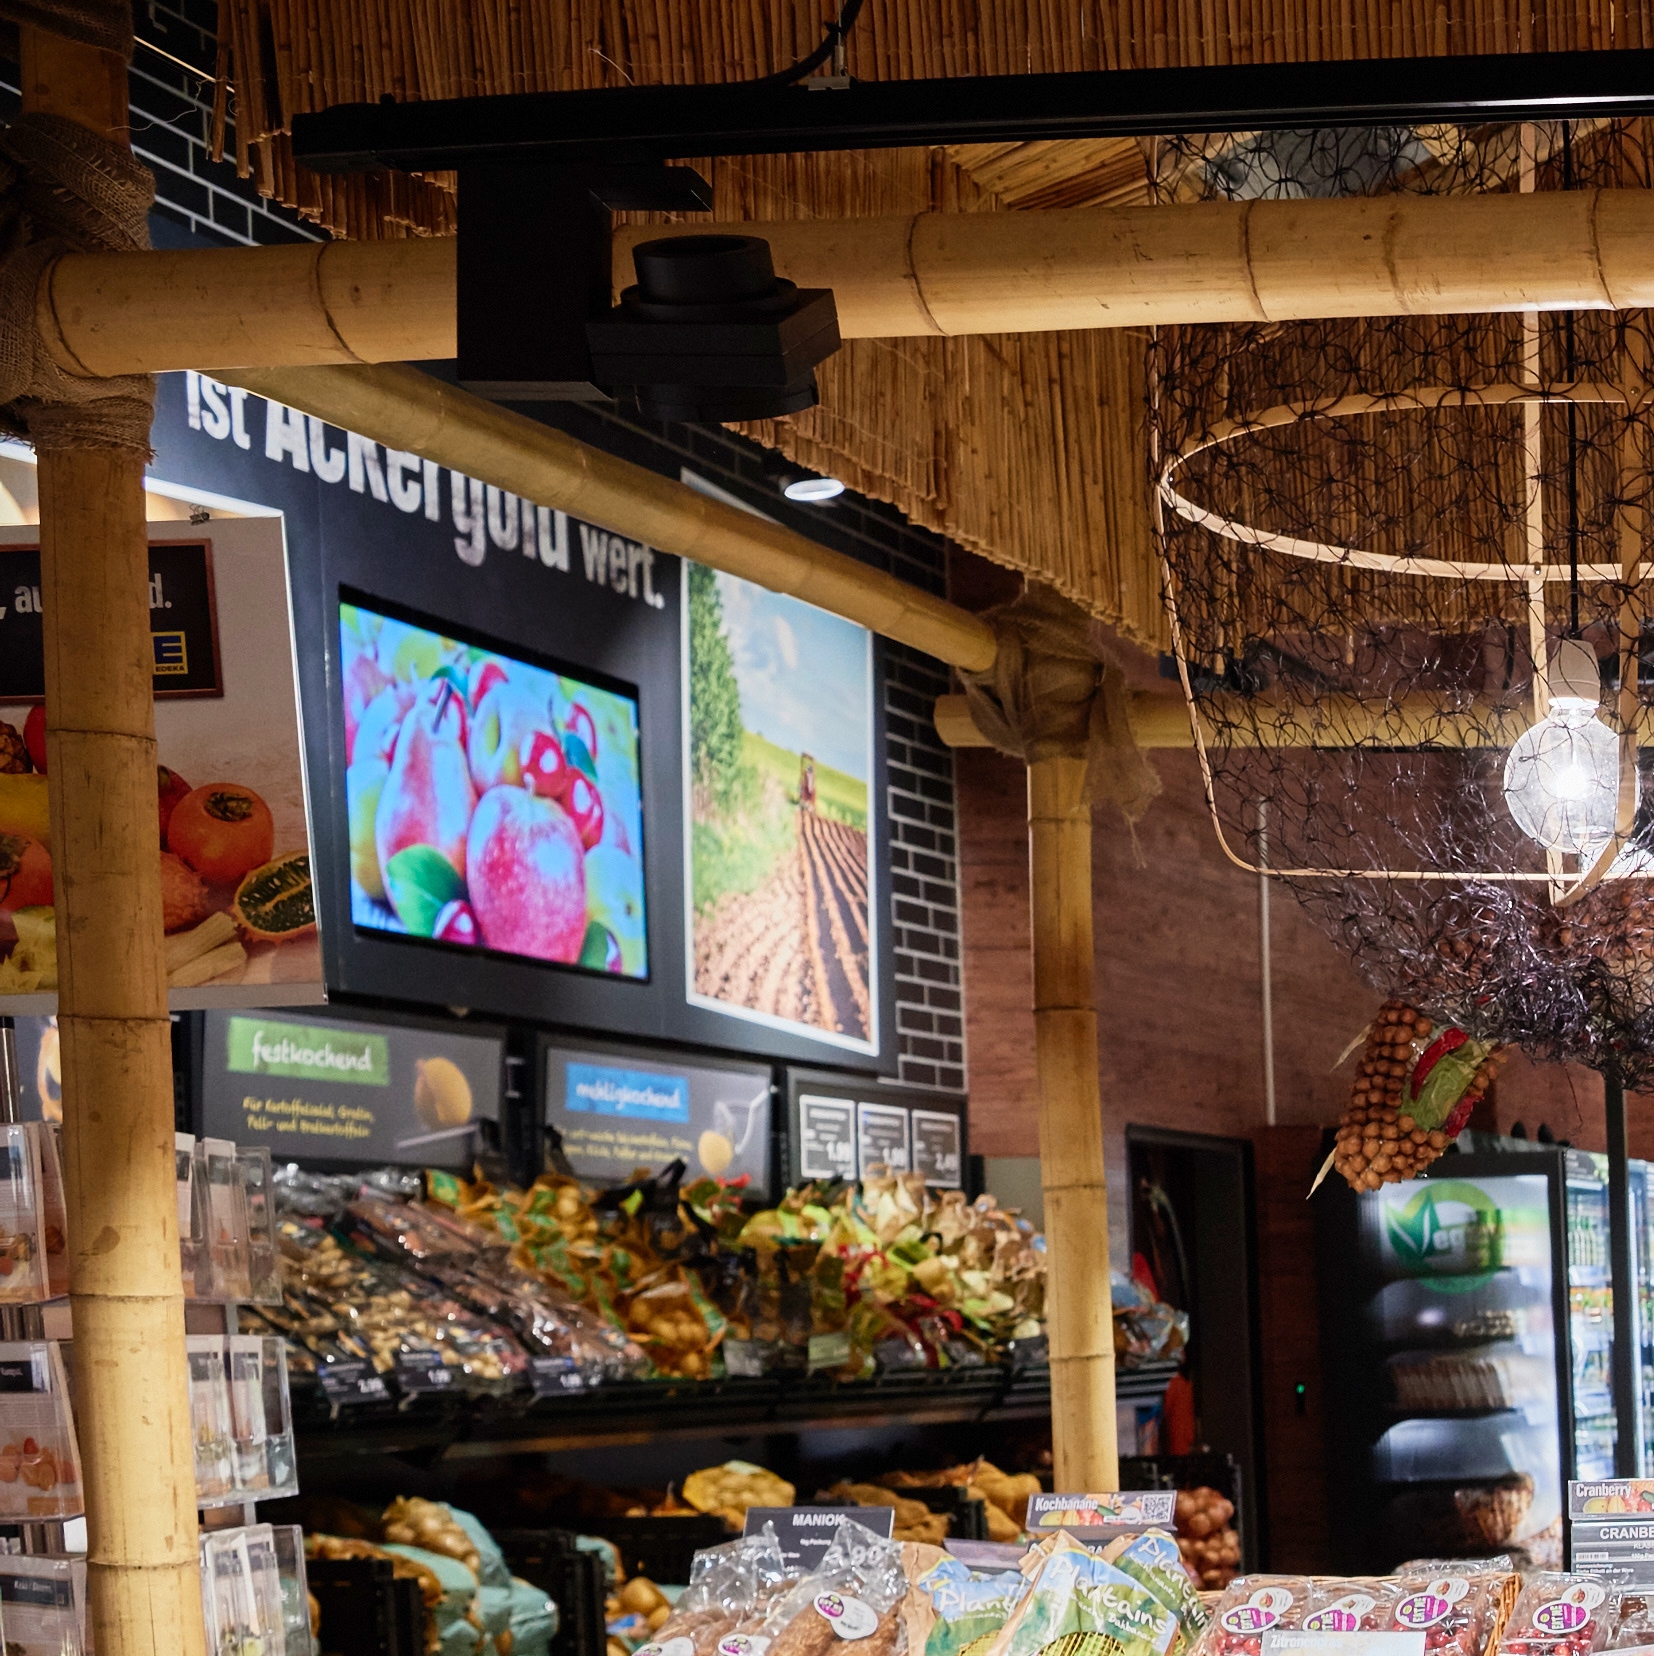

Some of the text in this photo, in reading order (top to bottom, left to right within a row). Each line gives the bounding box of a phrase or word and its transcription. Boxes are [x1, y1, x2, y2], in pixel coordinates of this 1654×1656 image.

[579, 524, 665, 609] wert.
[251, 1030, 372, 1072] festkochend
[1035, 1498, 1098, 1512] Kochbanane
[1576, 1484, 1632, 1498] Cranberry
[793, 1514, 844, 1526] MANIOK
[1050, 1557, 1167, 1635] Plantains
